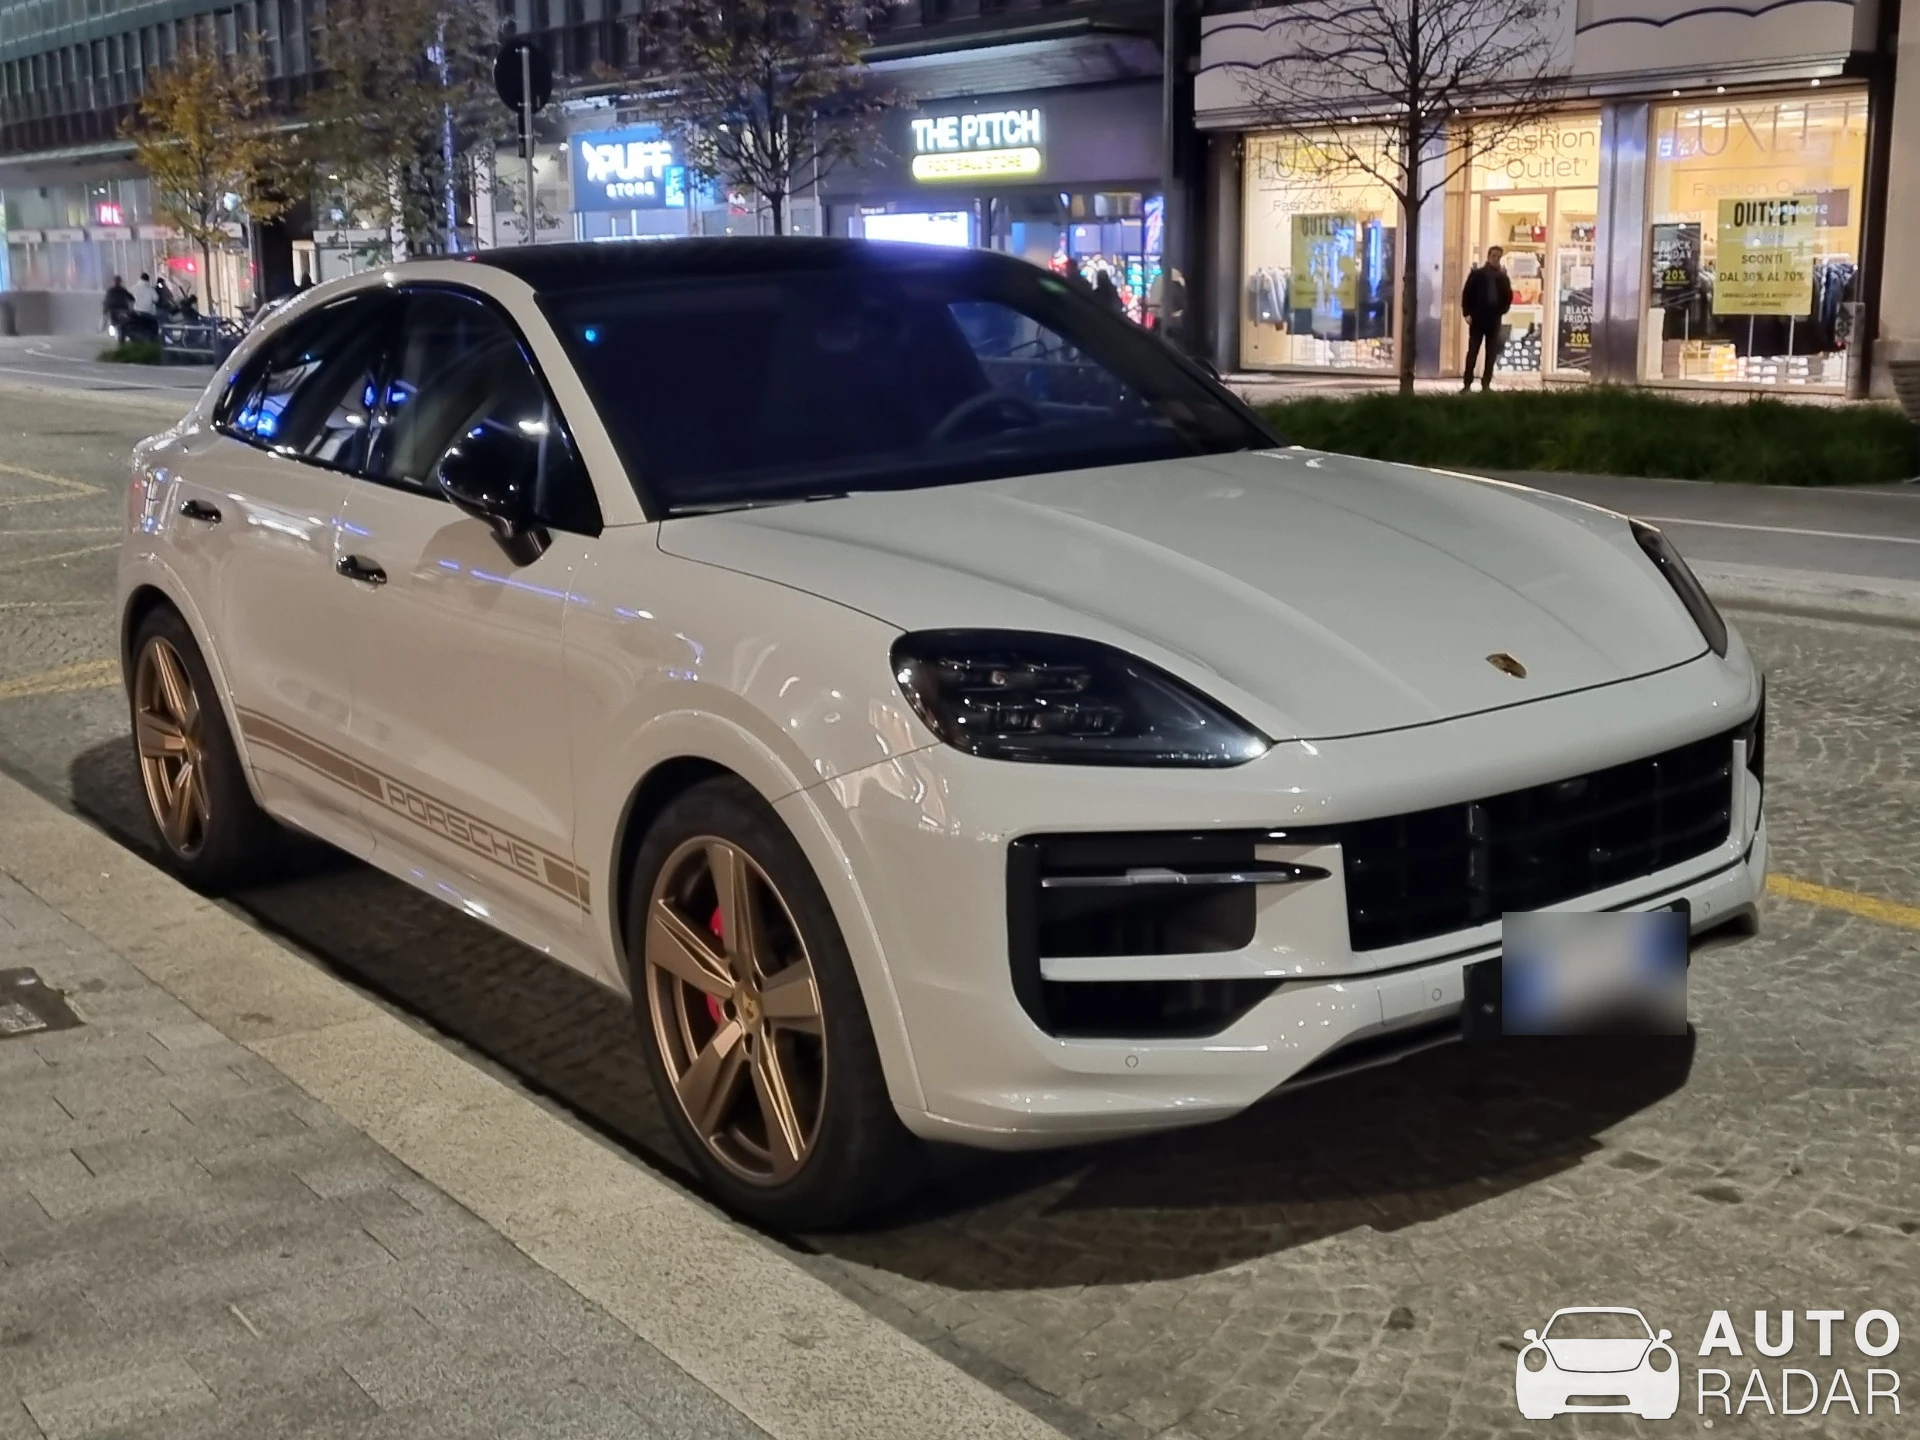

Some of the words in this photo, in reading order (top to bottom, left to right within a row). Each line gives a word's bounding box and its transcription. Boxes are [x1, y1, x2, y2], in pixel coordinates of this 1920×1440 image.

[911, 116, 959, 151] THE
[961, 108, 1041, 147] PITCH
[596, 141, 672, 181] PUFF
[1506, 157, 1581, 178] Outlet
[606, 181, 655, 198] STORE
[1741, 254, 1783, 265] SCONTI
[1665, 269, 1686, 280] 20%
[1719, 272, 1739, 282] DAL
[1767, 271, 1780, 282] AL
[1783, 271, 1805, 281] 70%
[1566, 305, 1593, 315] BLACK
[1564, 314, 1594, 324] FRIDAY
[1570, 333, 1590, 343] 20%
[387, 782, 539, 877] PORSCHE
